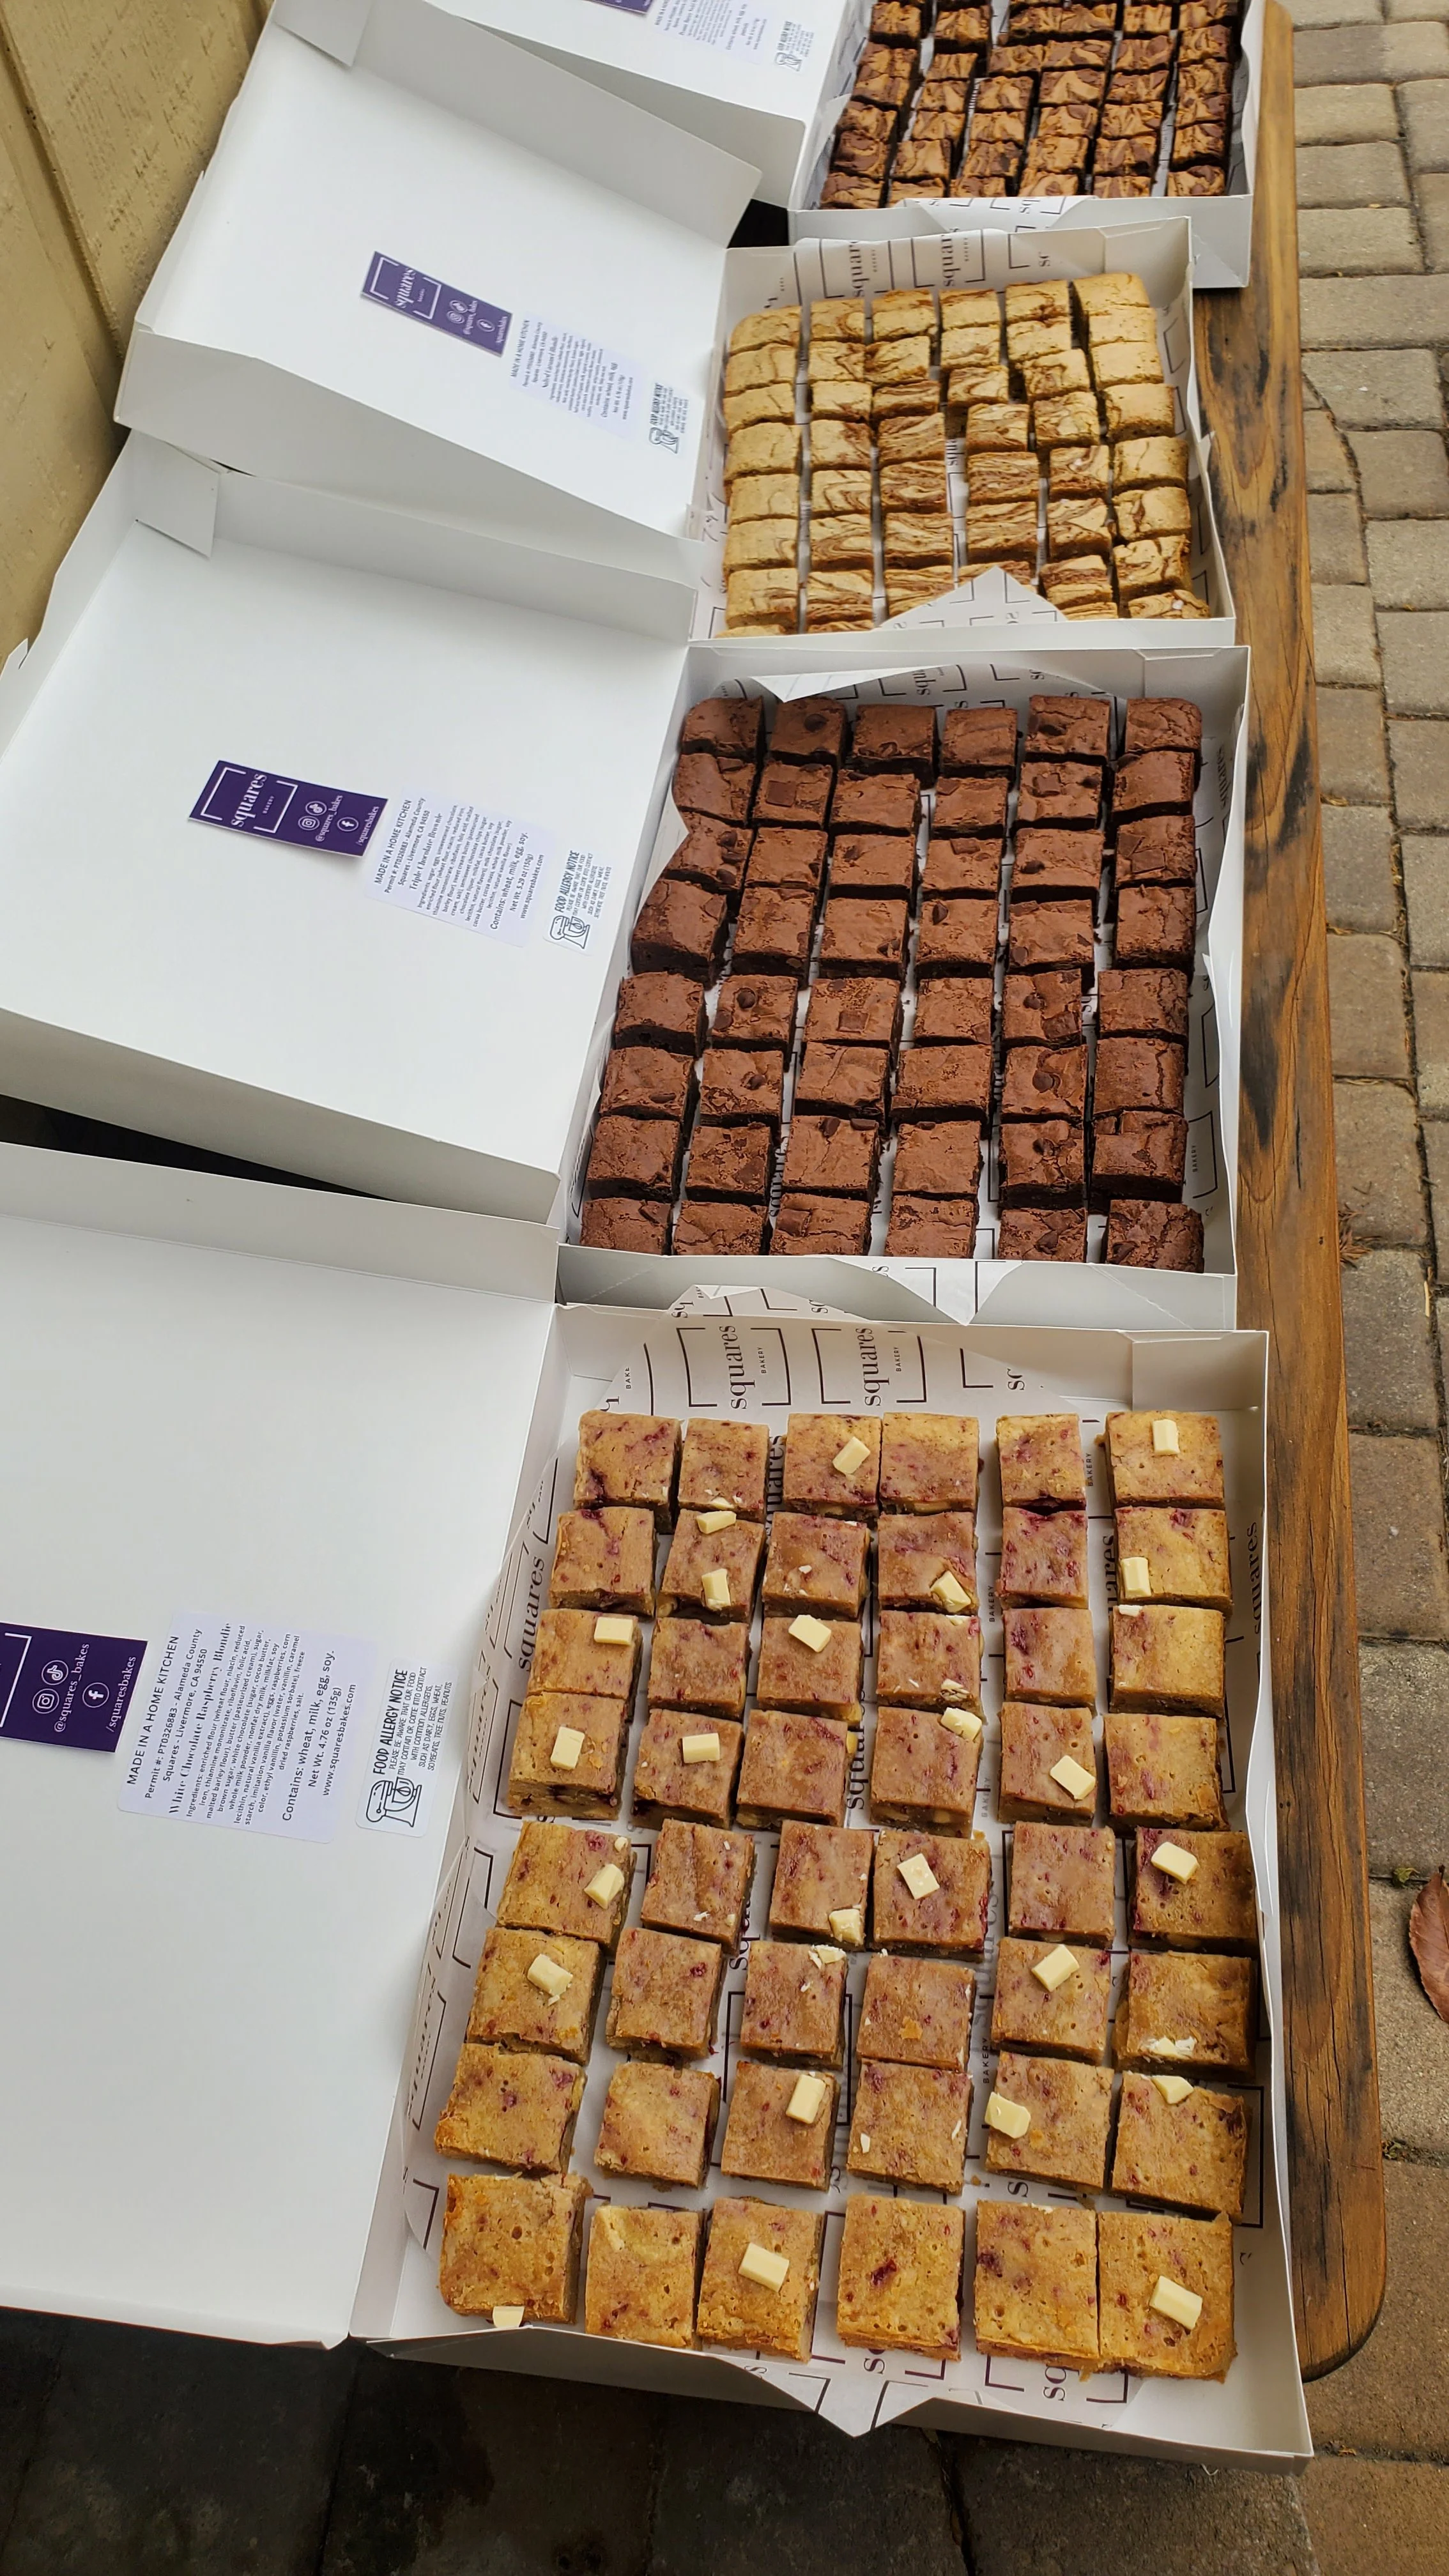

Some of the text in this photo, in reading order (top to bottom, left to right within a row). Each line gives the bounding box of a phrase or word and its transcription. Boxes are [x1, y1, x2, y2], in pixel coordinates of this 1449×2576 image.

[231, 774, 267, 827] squares
[374, 863, 388, 884] MADE
[381, 855, 392, 864] IN
[387, 828, 401, 849] HOME
[395, 799, 412, 829] KITCHEN
[384, 797, 426, 894] Permit Alameda County
[397, 864, 411, 886] Squares
[409, 813, 443, 890] Triple Chocolate Brownie
[520, 854, 544, 919] www.squaresbakes.com
[554, 850, 580, 913] FOOD ALLERGY NOTICE
[489, 898, 507, 930] Contains:
[509, 900, 519, 912] Net
[719, 1326, 755, 1410] squares
[757, 1347, 766, 1374] BAKERY
[855, 1327, 889, 1407] squares
[288, 1635, 300, 1663] caramel
[517, 1556, 545, 1673] squares
[54, 1644, 89, 1733] @squares_bakes
[105, 1657, 136, 1733] /squaresbakes
[126, 1636, 180, 1784] MADE IN A HOME KITCHEN
[144, 1767, 161, 1798] Permit
[157, 1707, 178, 1754] PT0326883
[174, 1662, 192, 1701] Alameda
[185, 1629, 203, 1660] County
[162, 1648, 208, 1782] Squares Livermore, CA 94550
[168, 1623, 231, 1813] White Chocolate Raspberry Blondie
[186, 1625, 245, 1817] Ingredients: enriched flour (wheat flour, niacin, reduced
[204, 1755, 218, 1788] thiamine
[236, 1655, 247, 1670] folic
[243, 1766, 256, 1793] natural
[250, 1741, 262, 1765] vanilla
[282, 1634, 291, 1649] corn
[264, 1772, 273, 1791] ethyl
[277, 1705, 291, 1742] potassium
[293, 1651, 305, 1673] freeze
[372, 1669, 408, 1775] FOOD ALLERGY NOTICE
[406, 1672, 417, 1688] FOOD
[206, 1792, 218, 1819] malted
[212, 1768, 226, 1791] barley
[225, 1722, 238, 1744] butter
[232, 1678, 250, 1721] (pasteurized
[216, 1788, 229, 1812] brown
[231, 1744, 241, 1764] white
[236, 1708, 251, 1743] chocolate
[254, 1663, 263, 1683] cocoa
[228, 1788, 239, 1810] whole
[235, 1770, 244, 1786] milk
[248, 1715, 259, 1739] nonfat
[254, 1702, 264, 1714] dry
[271, 1643, 280, 1655] soy
[261, 1740, 272, 1764] vanilla
[266, 1717, 278, 1739] flavor
[278, 1693, 304, 1770] dried raspberries, salt.
[282, 1650, 335, 1821] Contains: wheat, milk, egg, soy.
[307, 1687, 342, 1788] Net Wt. 4.76 oz (135g)
[322, 1684, 356, 1796] www.squaresbakes.com
[250, 1765, 265, 1798] imitation
